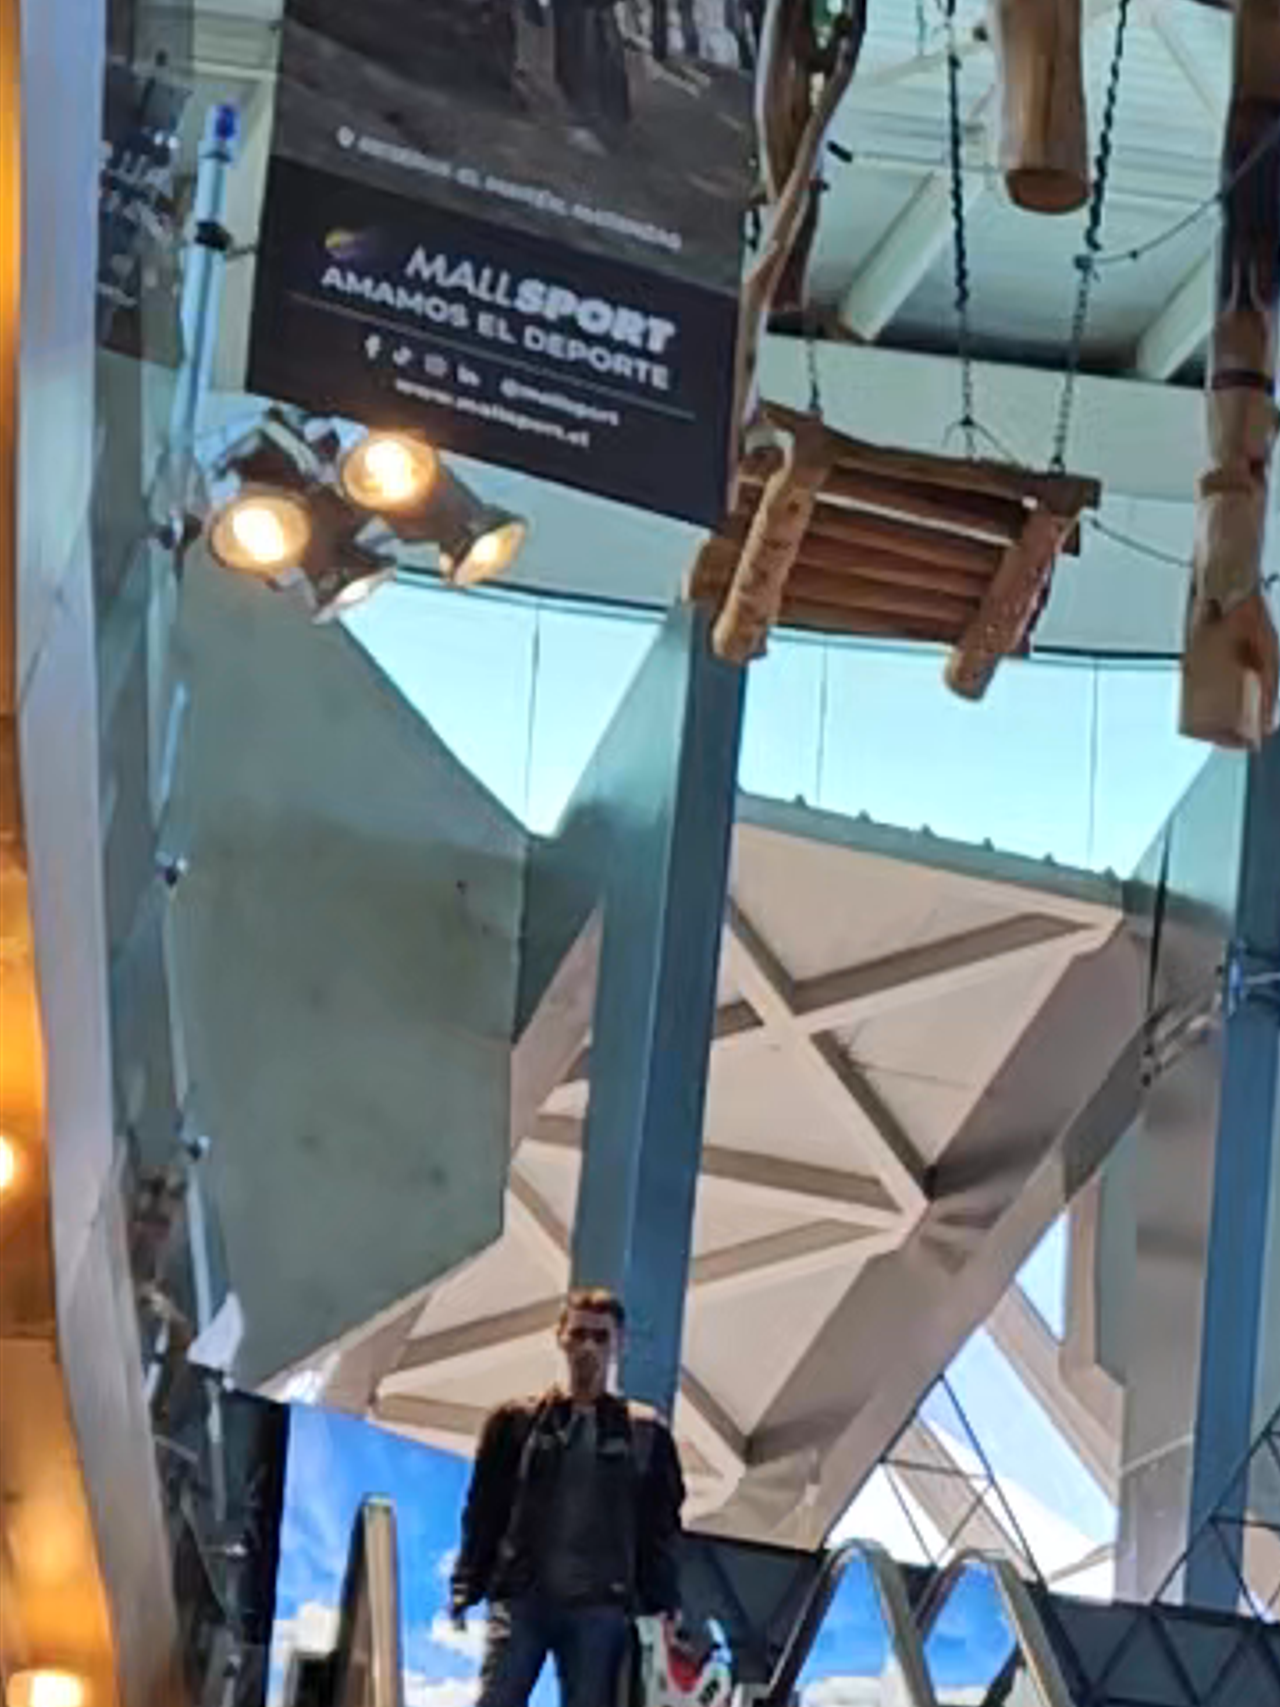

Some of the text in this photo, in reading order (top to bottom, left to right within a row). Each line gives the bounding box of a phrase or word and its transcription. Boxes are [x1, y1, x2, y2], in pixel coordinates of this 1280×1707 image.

[321, 266, 670, 391] AMAMOS EL DEPORTE
[405, 244, 677, 354] MALLSPORT
